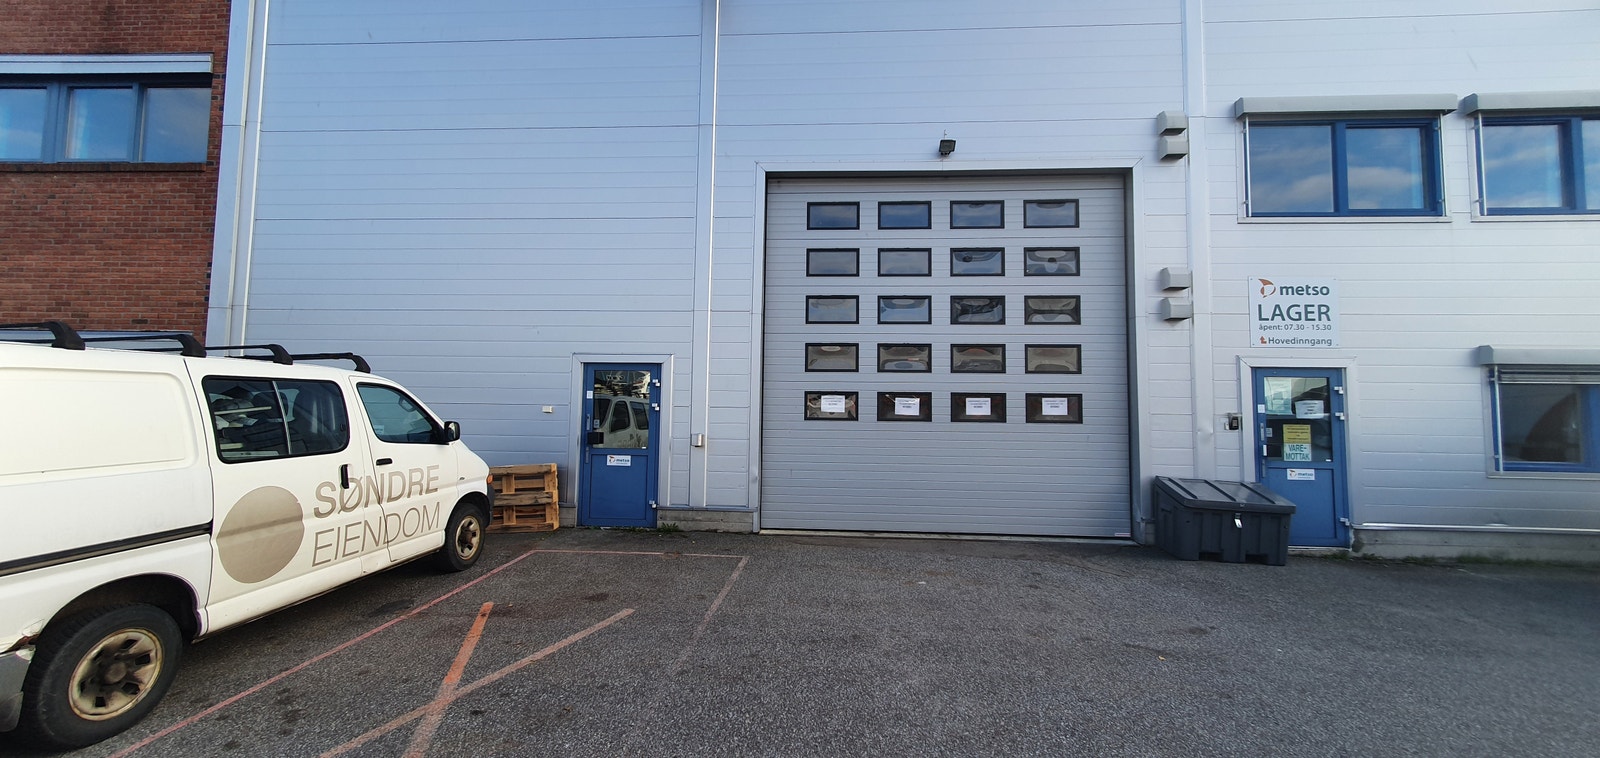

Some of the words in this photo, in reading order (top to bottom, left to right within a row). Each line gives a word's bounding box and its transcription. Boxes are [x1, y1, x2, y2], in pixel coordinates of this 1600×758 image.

[1280, 284, 1330, 296] metso
[1258, 304, 1331, 322] LAGER
[1258, 324, 1282, 332] åpent:
[1268, 337, 1332, 346] Hovedinngang
[314, 464, 440, 518] SØNDRE
[312, 502, 440, 568] EIENDOM
